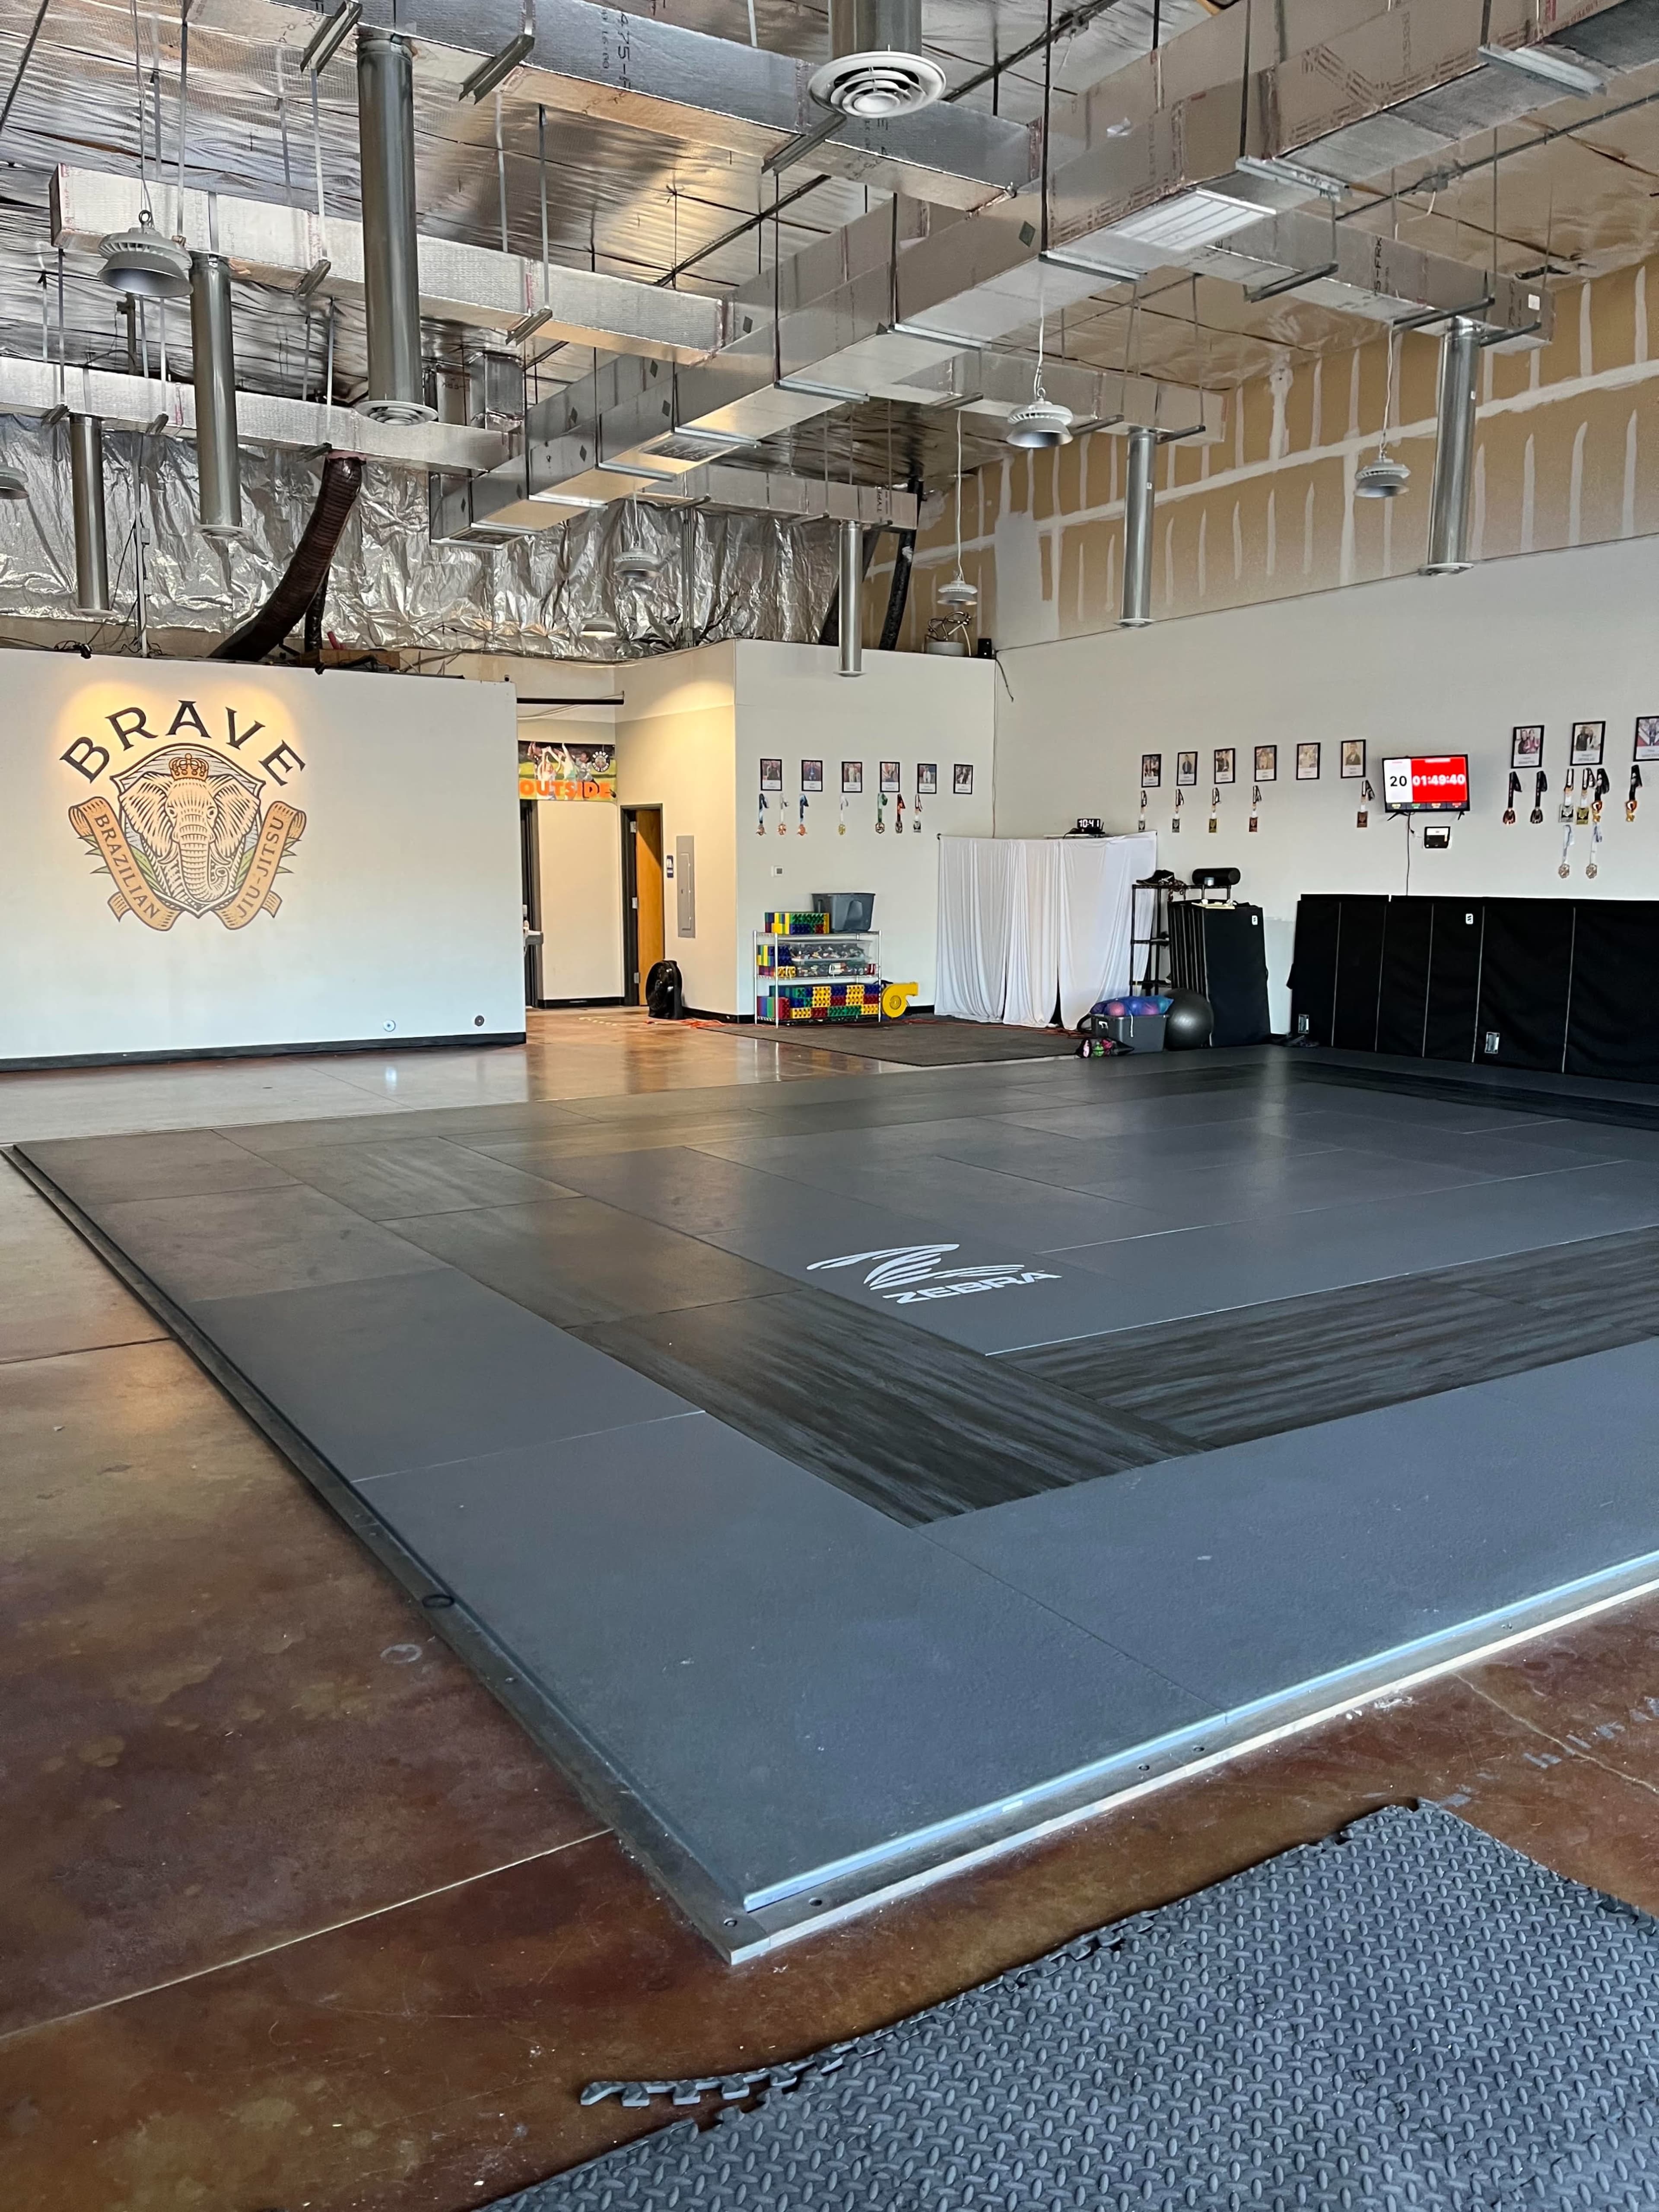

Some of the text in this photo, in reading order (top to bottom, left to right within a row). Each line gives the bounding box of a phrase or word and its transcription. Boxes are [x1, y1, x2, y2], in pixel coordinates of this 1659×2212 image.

[59, 700, 305, 786] BRAVE
[520, 780, 612, 798] OUTSIDE
[1390, 774, 1465, 786] 20 01:49:40
[1078, 819, 1099, 828] 10:41
[95, 814, 160, 918] BRAZILIAN
[237, 817, 284, 918] JIU-JITSU
[883, 1271, 1062, 1304] ZEBRA
